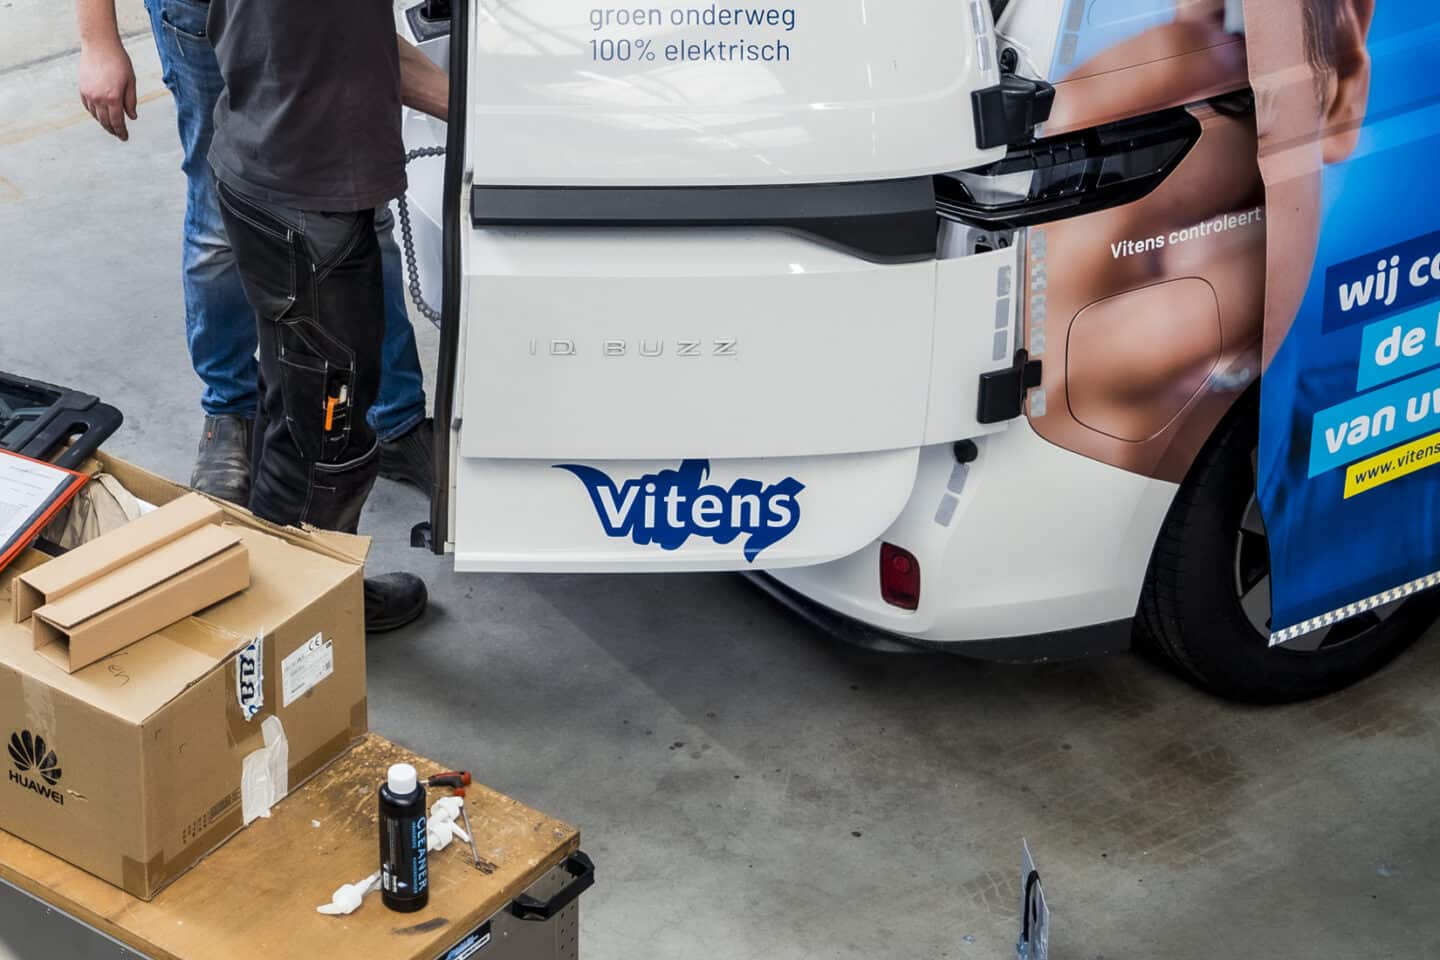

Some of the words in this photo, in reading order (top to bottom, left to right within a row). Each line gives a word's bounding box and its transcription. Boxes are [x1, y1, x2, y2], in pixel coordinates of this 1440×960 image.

[589, 7, 662, 31] groen
[670, 4, 796, 31] onderweg
[589, 39, 656, 62] 100%
[665, 39, 790, 62] elektrisch
[1111, 235, 1166, 259] Vitens
[1169, 207, 1262, 245] controleert
[1338, 255, 1401, 312] wij
[603, 339, 737, 357] BUZZ
[1374, 325, 1426, 367] de
[1324, 405, 1397, 455] van
[595, 482, 793, 529] Vitens
[8, 769, 64, 806] HUAWEI
[416, 816, 428, 892] CLEANER
